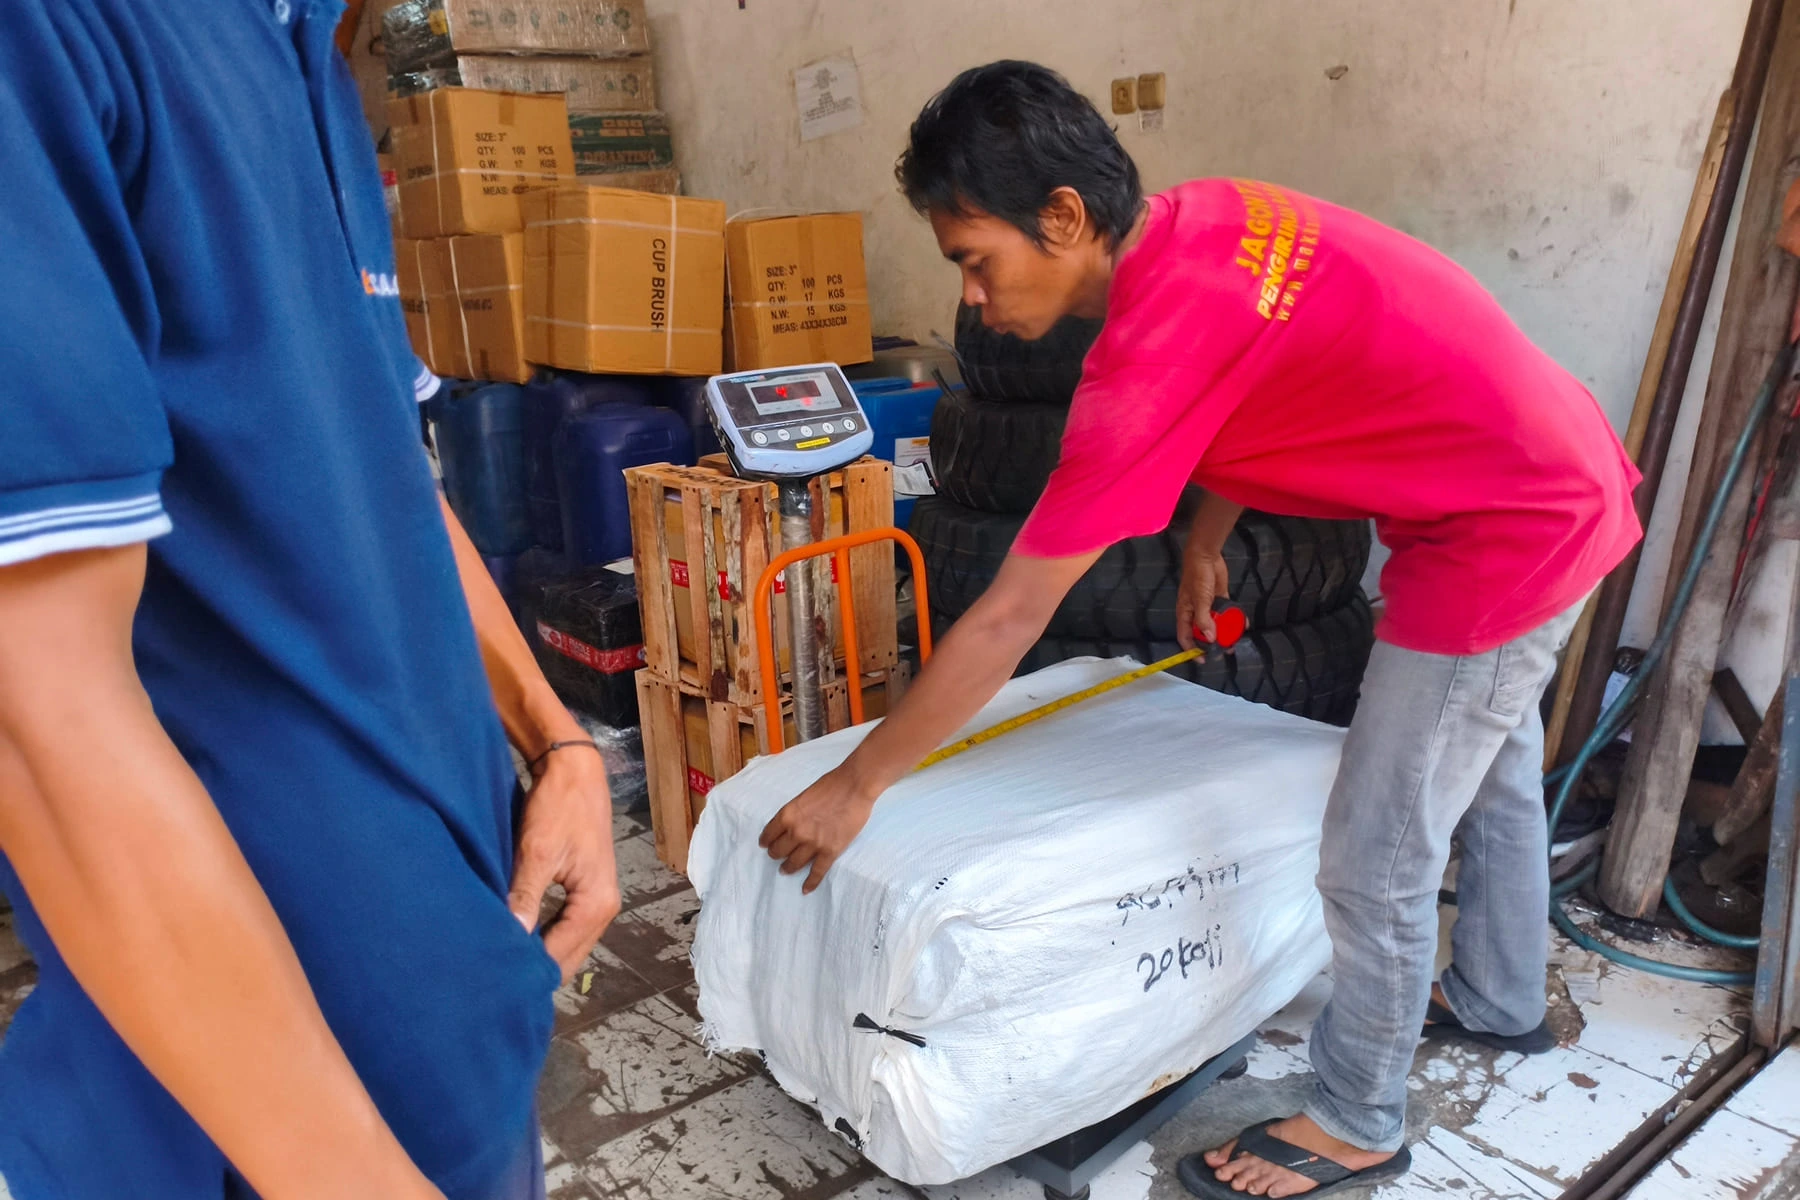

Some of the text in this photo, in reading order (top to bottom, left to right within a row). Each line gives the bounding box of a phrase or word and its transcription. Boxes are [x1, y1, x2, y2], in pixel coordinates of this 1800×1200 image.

[766, 266, 788, 278] SIZE:
[650, 238, 666, 333] CUP BRUSH
[768, 274, 843, 292] QTY: 100 PCS
[805, 292, 813, 302] 17
[828, 288, 845, 299] KGS
[807, 305, 815, 316] 15
[772, 322, 798, 334] MEAS:
